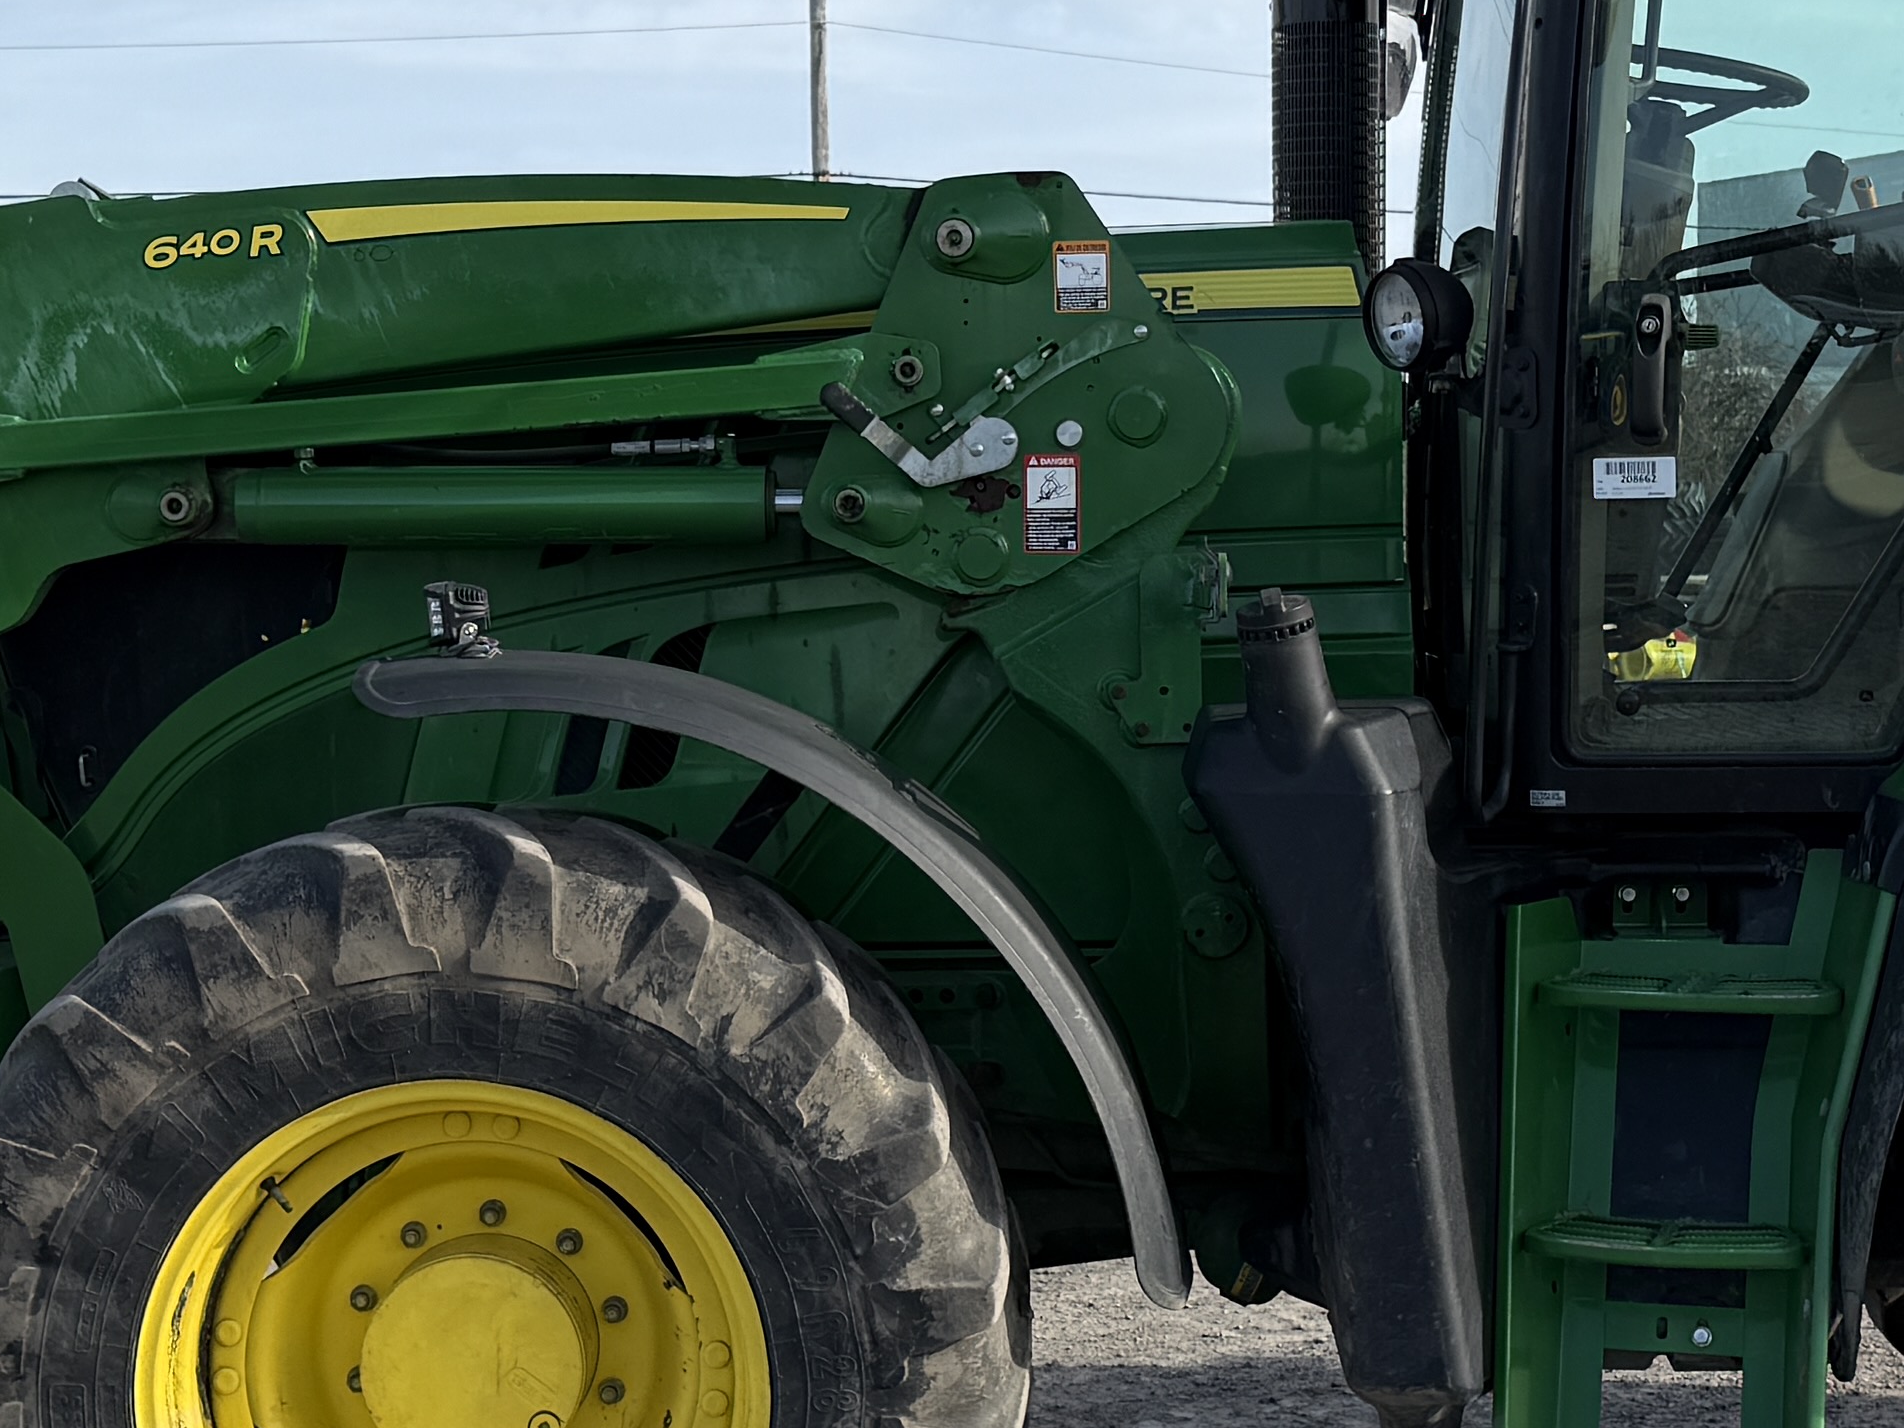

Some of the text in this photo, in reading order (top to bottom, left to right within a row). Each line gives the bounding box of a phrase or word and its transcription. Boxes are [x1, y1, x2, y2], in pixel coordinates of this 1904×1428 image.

[144, 223, 283, 269] 640 R
[1039, 457, 1075, 466] DANGER
